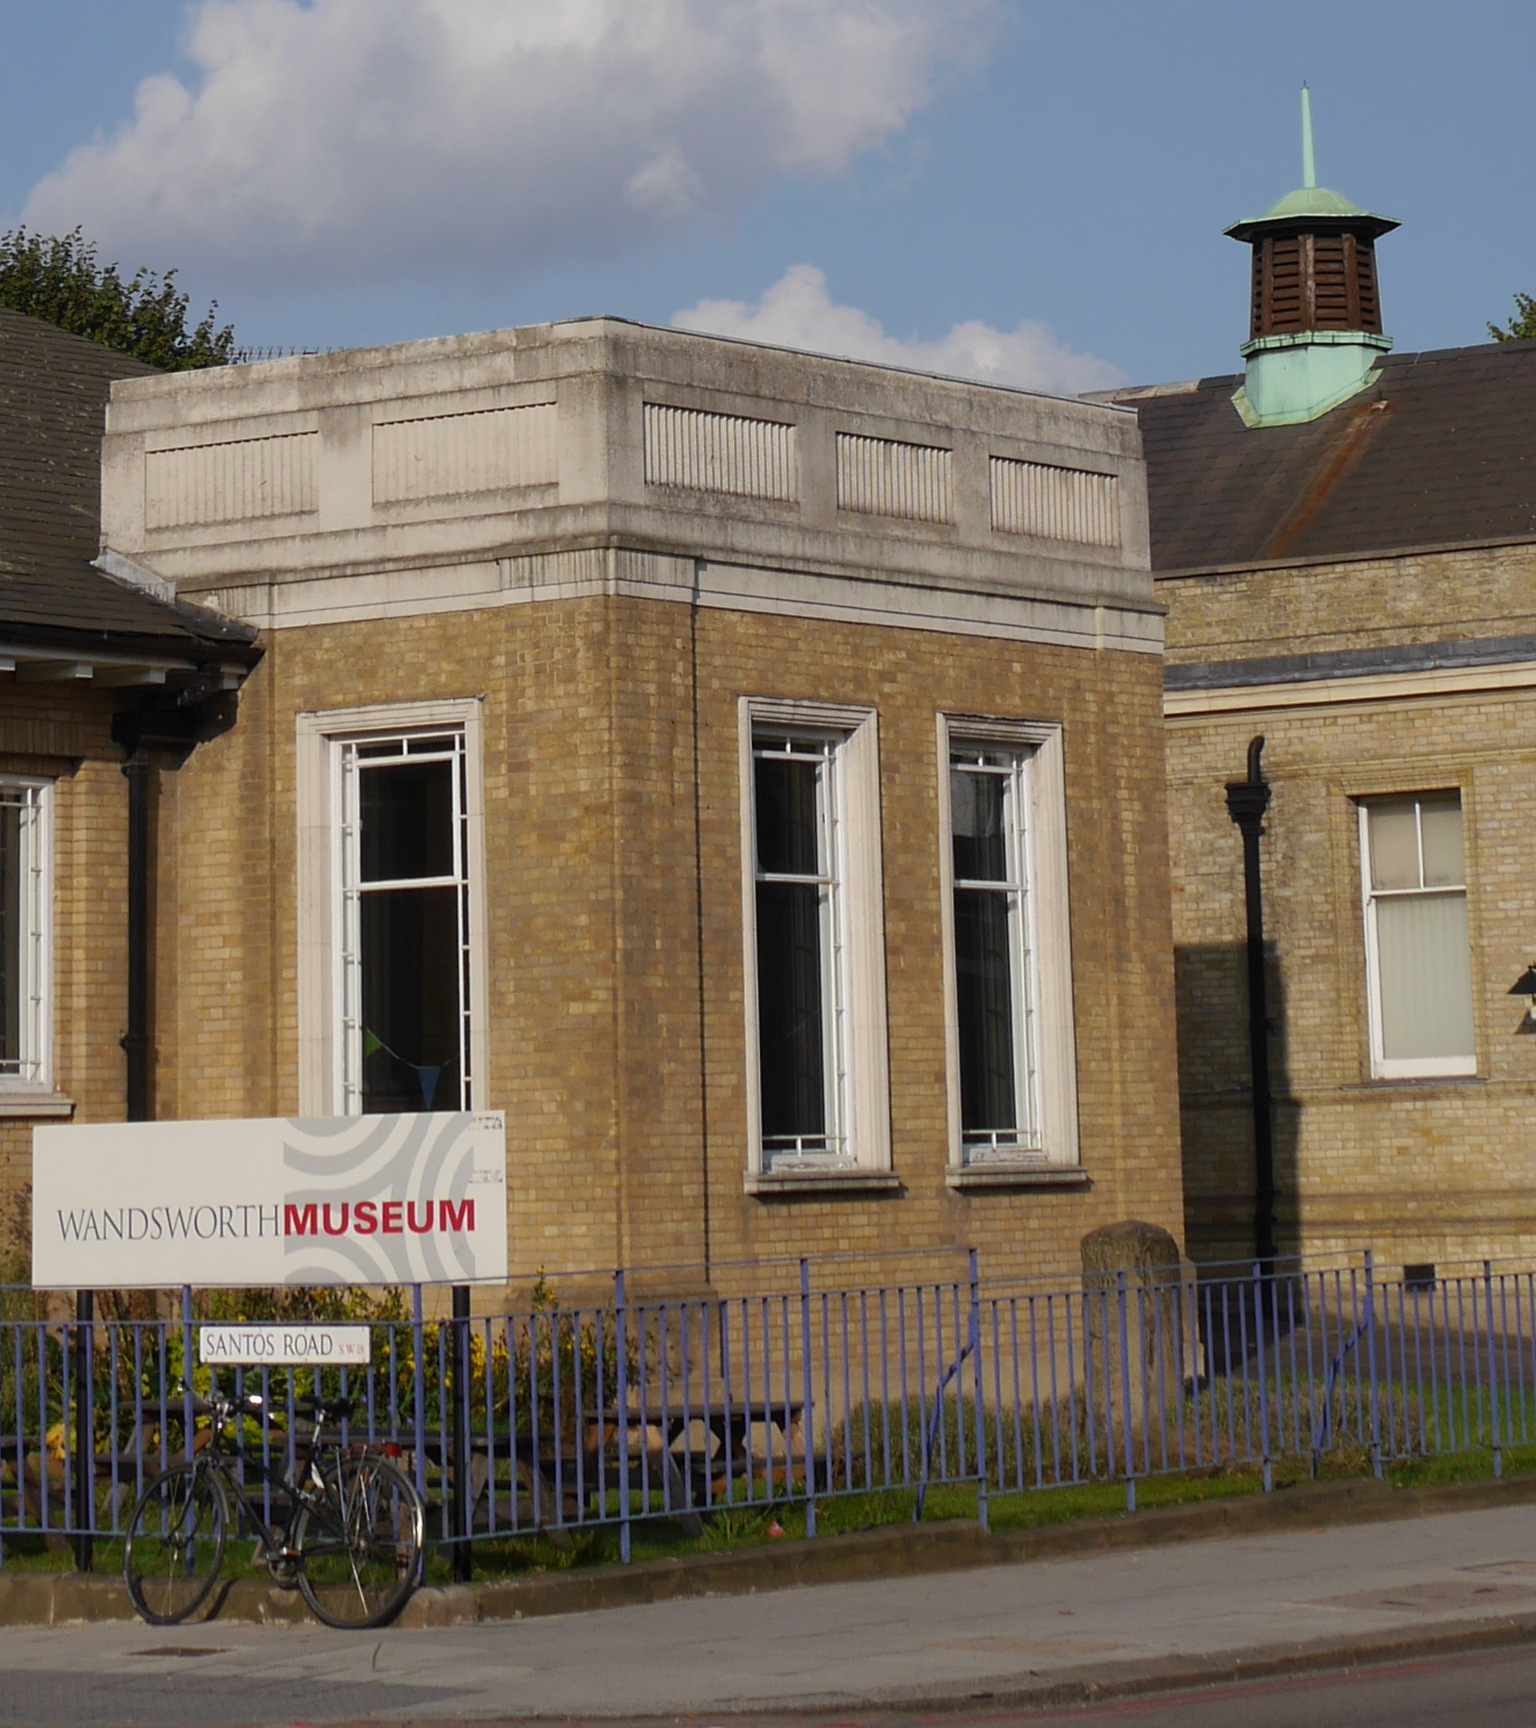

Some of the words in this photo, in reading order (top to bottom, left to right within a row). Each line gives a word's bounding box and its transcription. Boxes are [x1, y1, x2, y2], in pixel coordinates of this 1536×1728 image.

[57, 1203, 281, 1242] WANDSWORTH
[283, 1199, 475, 1237] MUSEUM
[206, 1334, 276, 1356] SANTOS
[283, 1334, 334, 1356] ROAD
